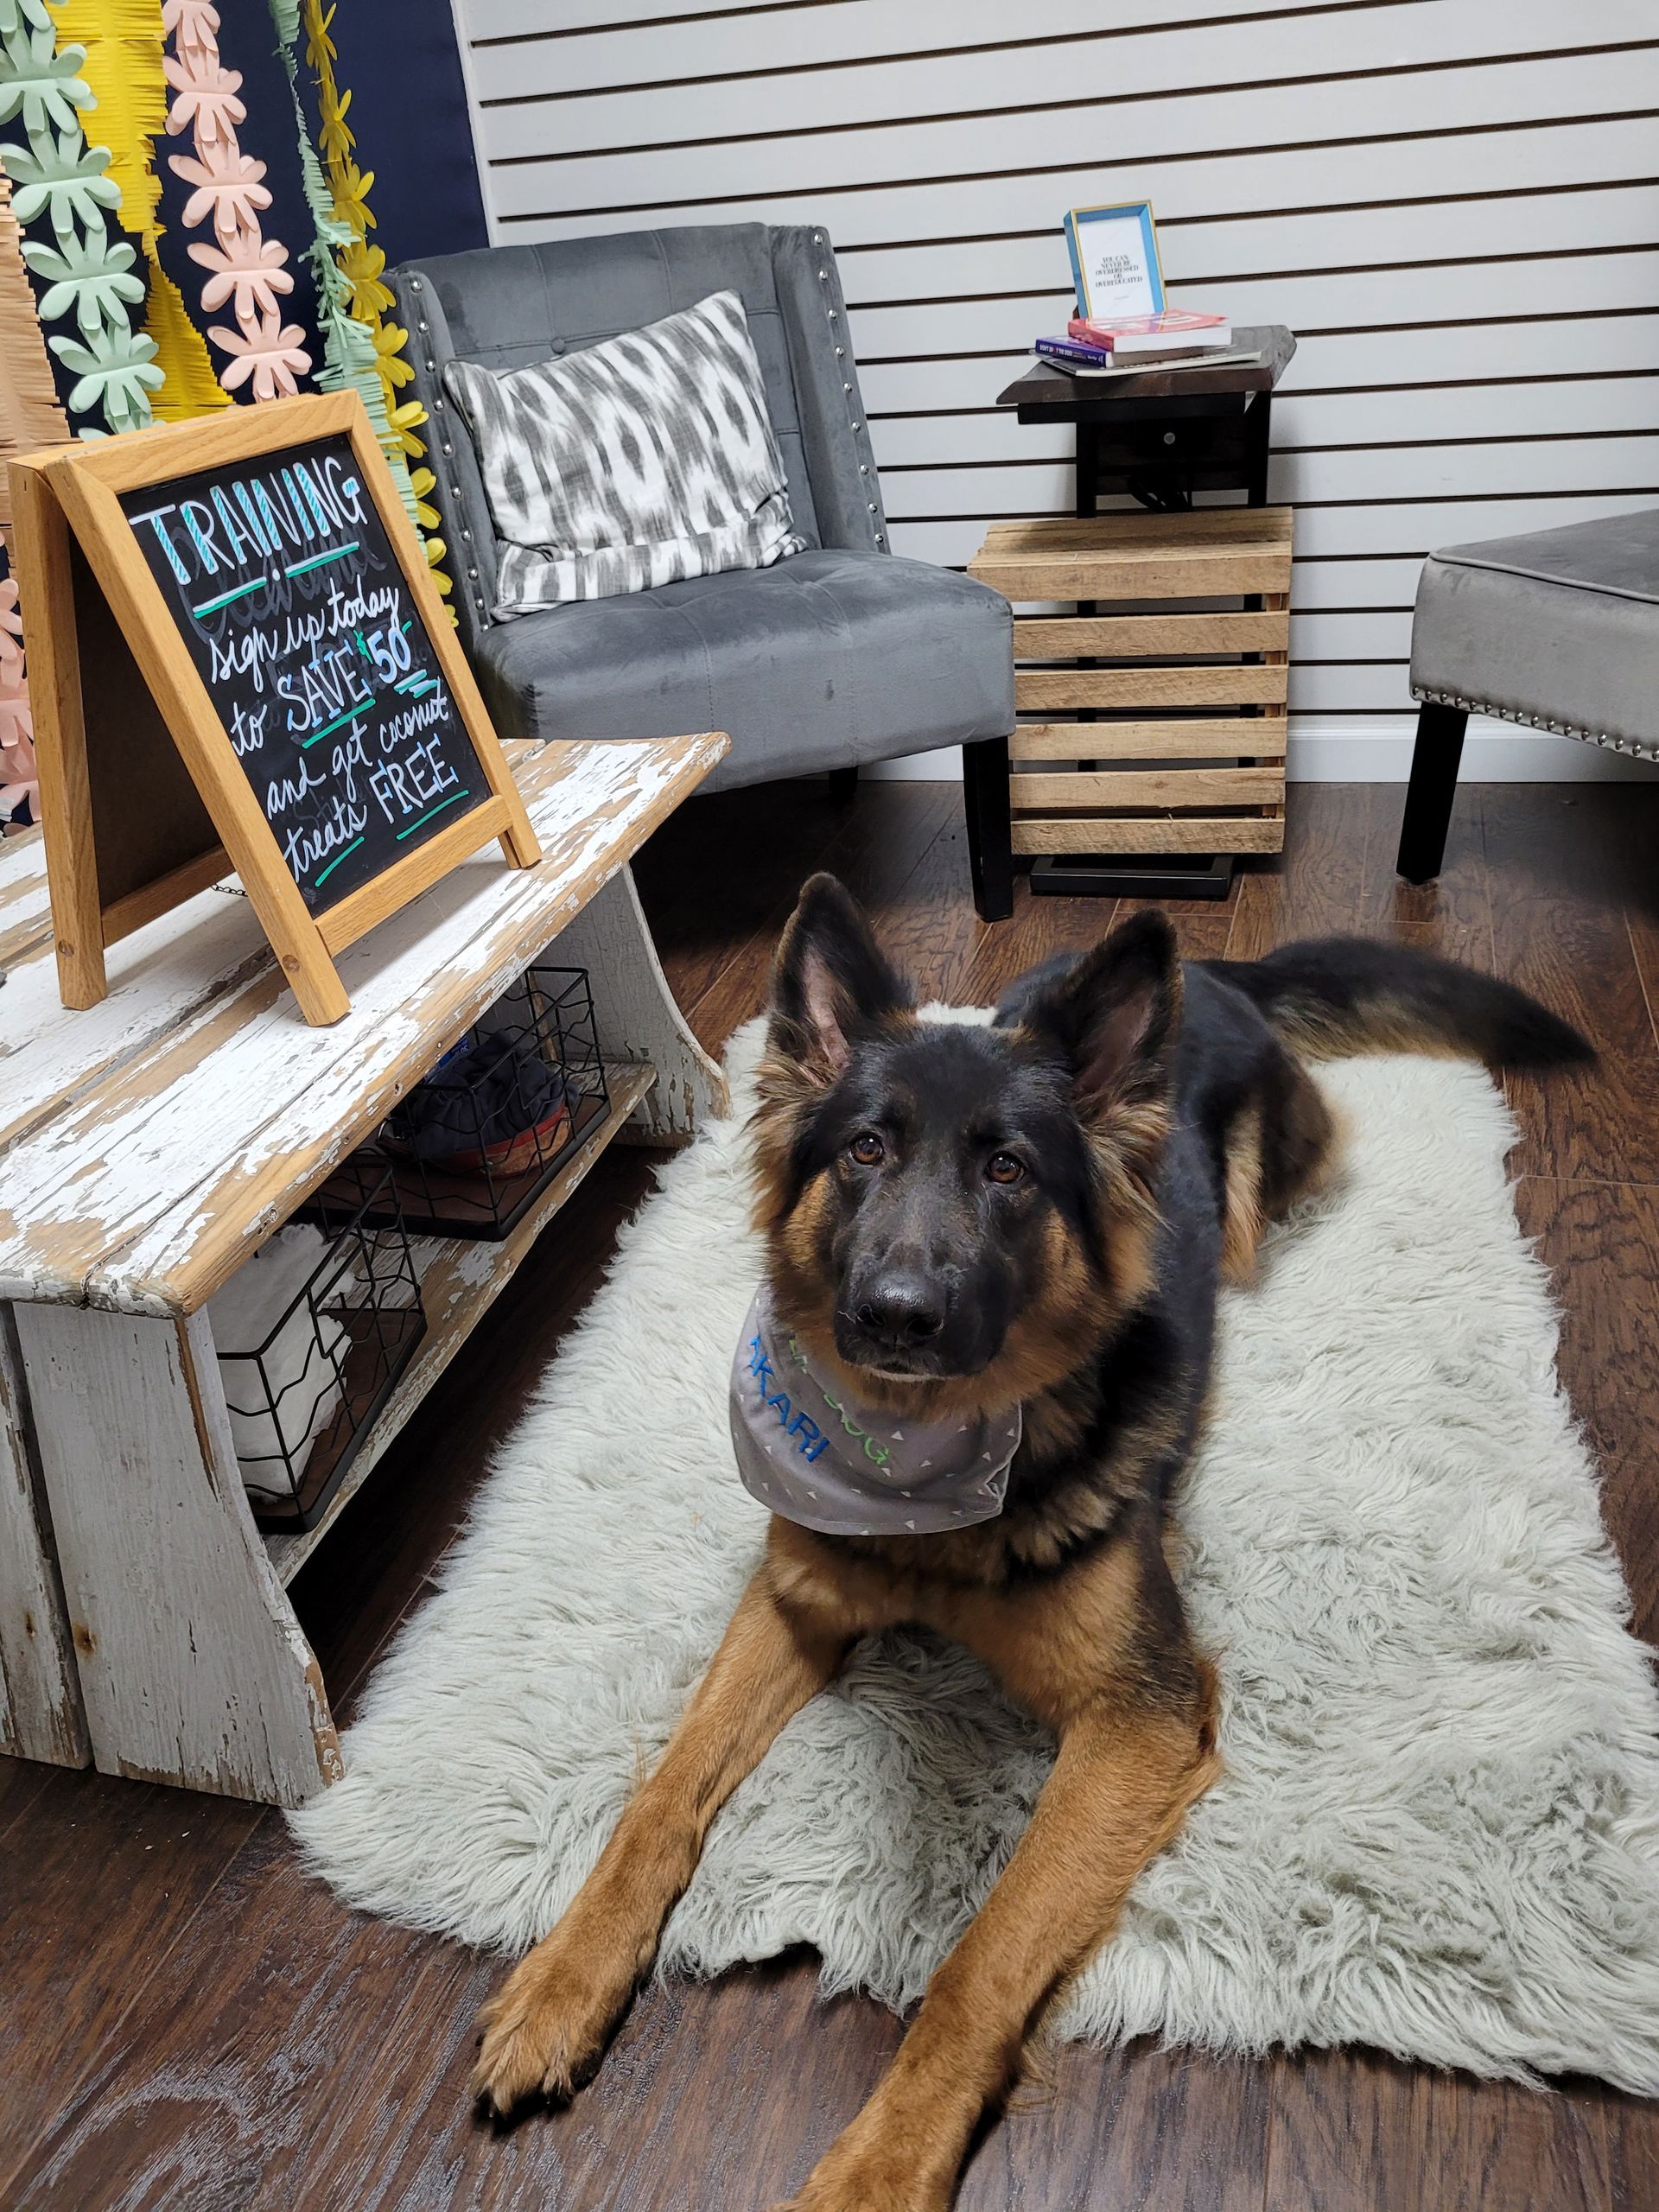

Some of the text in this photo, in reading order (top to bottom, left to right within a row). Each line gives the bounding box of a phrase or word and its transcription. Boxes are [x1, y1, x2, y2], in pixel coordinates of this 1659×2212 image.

[128, 455, 368, 586] TRAINING
[209, 626, 280, 692] sign
[283, 608, 326, 664] up
[327, 574, 399, 637] today
[231, 702, 268, 757] to
[277, 639, 372, 732] SAVE
[267, 676, 449, 820] and get coconut
[283, 733, 460, 884] treats FREE
